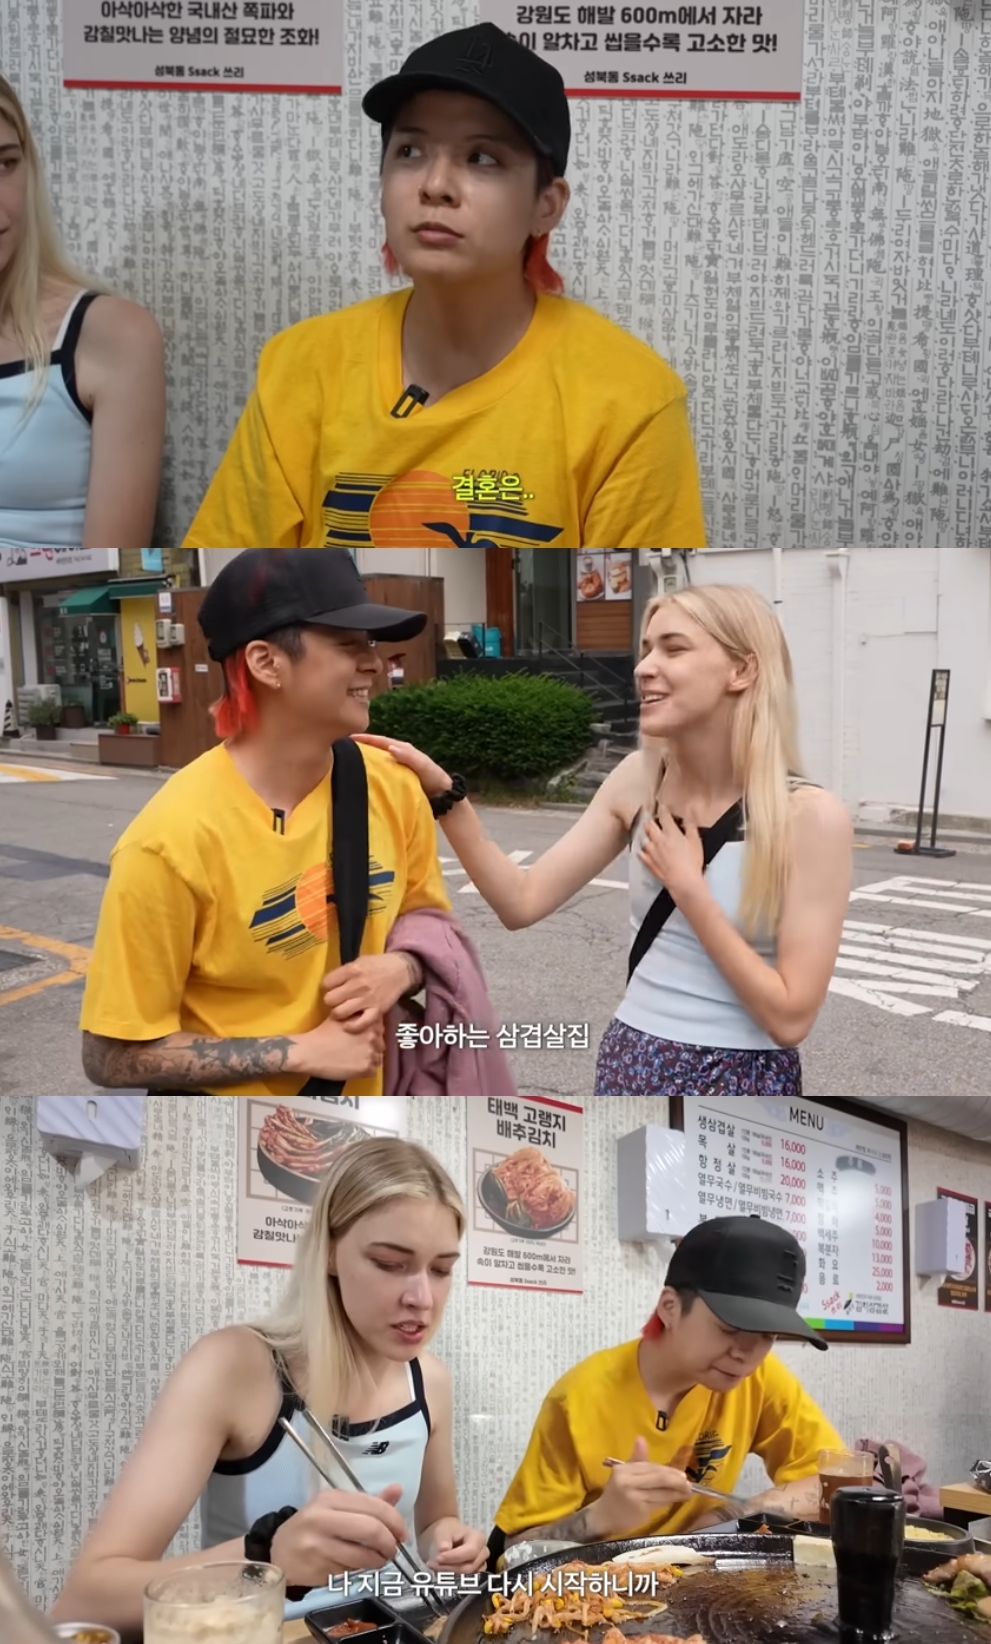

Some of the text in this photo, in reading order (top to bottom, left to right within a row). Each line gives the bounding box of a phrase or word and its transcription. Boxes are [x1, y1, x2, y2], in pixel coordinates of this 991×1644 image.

[101, 1, 295, 21] 아삭아삭한 국내산 쪽파와
[516, 5, 763, 26] 강원도 해발 600m에서 자라
[83, 25, 320, 46] 감칠맛나는 양념의 절묘한 조화!
[543, 32, 598, 51] 알차고
[604, 33, 681, 52] 씹을수록
[686, 34, 747, 53] 고소한
[752, 34, 778, 53] 맛!
[154, 65, 244, 79] 성북동 Ssack 쓰리
[584, 71, 688, 84] 성북동 Ssack 쓰리
[487, 1096, 567, 1132] 태백 고랭지
[789, 1106, 825, 1131] MENU
[496, 1119, 557, 1149] 배추김치
[698, 1115, 736, 1138] 생삼겹살
[780, 1138, 806, 1156] 16,000
[780, 1156, 806, 1173] 16,000
[780, 1173, 806, 1190] 20,000
[784, 1192, 806, 1208] 7,000
[785, 1210, 806, 1225] 7,000
[253, 1228, 298, 1243] 감칠맛나
